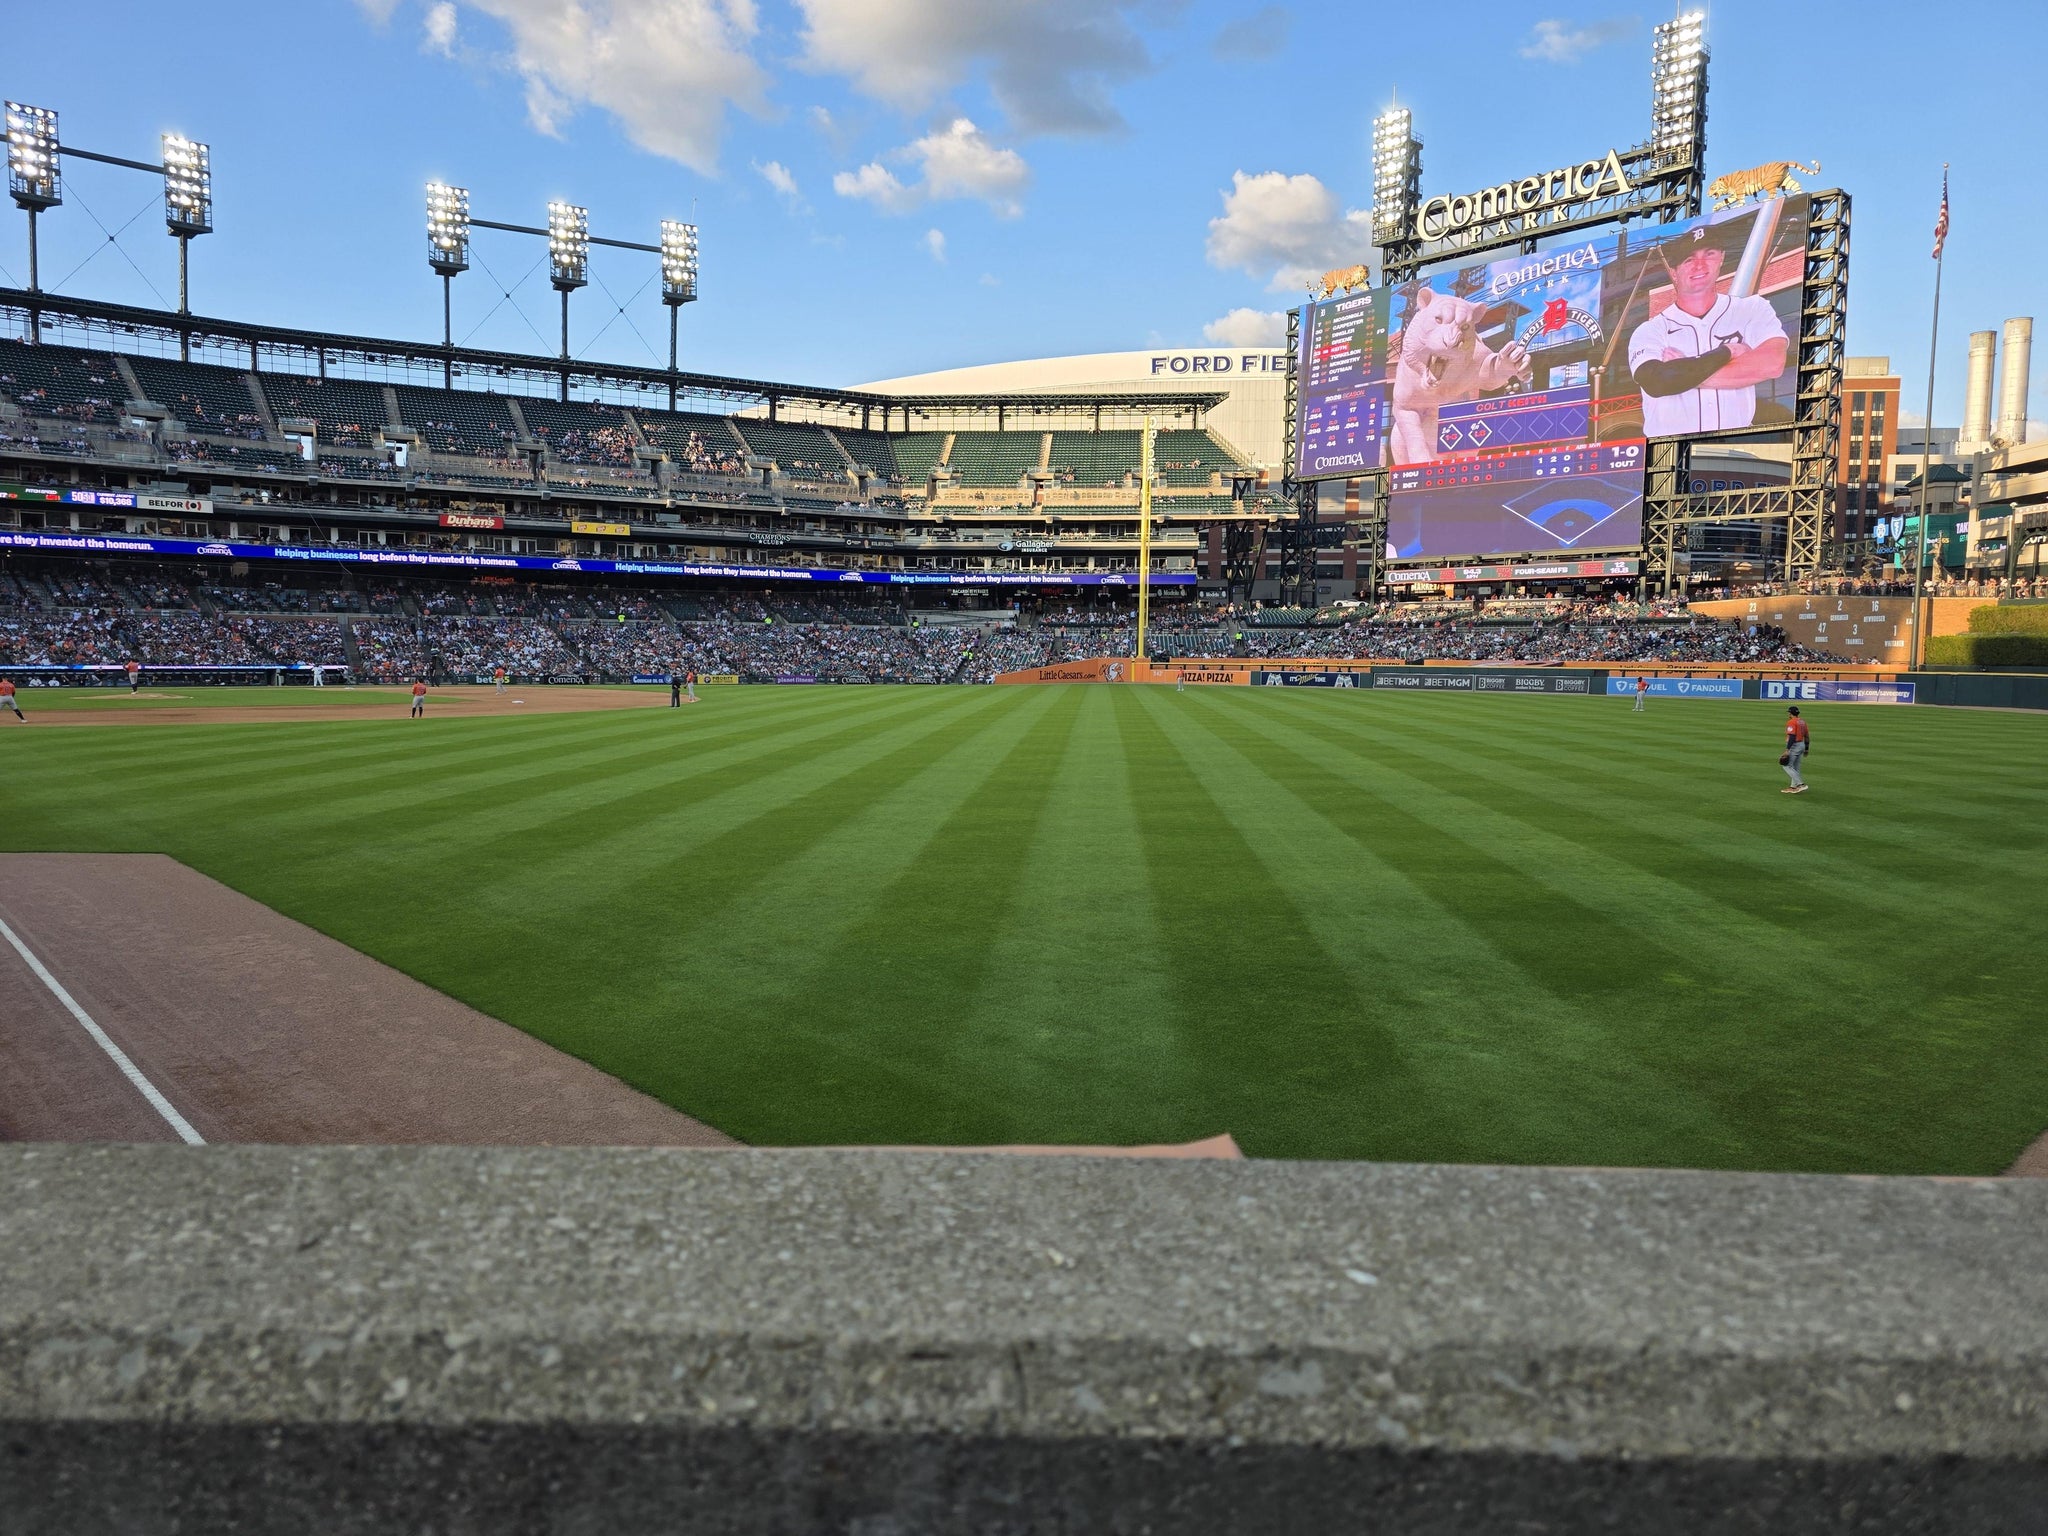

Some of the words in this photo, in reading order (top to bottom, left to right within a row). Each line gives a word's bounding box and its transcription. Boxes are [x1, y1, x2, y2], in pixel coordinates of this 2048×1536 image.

[1470, 204, 1569, 243] PARK
[1521, 275, 1569, 297] PARK
[1335, 296, 1372, 312] TIGERS
[1571, 311, 1601, 340] TIGERS
[1151, 355, 1233, 375] FORD
[1476, 401, 1505, 412] COLT
[1507, 395, 1548, 408] KEITH
[1611, 445, 1640, 459] 1-0
[1402, 470, 1419, 478] HOU
[1550, 455, 1558, 463] 2
[1563, 454, 1571, 462] 0
[1549, 467, 1557, 475] 2
[149, 500, 183, 508] BELFOR
[447, 515, 495, 527] Dunham's
[13, 535, 38, 547] they
[40, 537, 86, 546] invented
[87, 539, 105, 548] the
[106, 540, 154, 550] homerun.
[750, 533, 791, 542] CHAMPIONS
[1016, 541, 1054, 549] Gallagher
[275, 548, 309, 559] Helping
[310, 550, 358, 560] businesses
[359, 551, 379, 562] long
[379, 552, 407, 562] before
[408, 554, 428, 564] they
[429, 555, 464, 564] invented
[465, 556, 480, 565] the
[480, 557, 519, 567] homerun.
[615, 563, 644, 573] Helping
[644, 564, 683, 573] businesses
[684, 565, 699, 575] long
[700, 567, 723, 575] before
[723, 568, 739, 577] they
[739, 568, 769, 577] invented
[781, 570, 812, 579] homerun.
[890, 574, 915, 584] Helping
[915, 575, 950, 583] businesses
[950, 574, 965, 584] long
[965, 575, 987, 583] before
[986, 575, 1001, 584] they
[1002, 575, 1029, 583] invented
[1030, 575, 1042, 583] the
[1042, 575, 1073, 583] homerun.
[1749, 602, 1757, 612] 23
[1805, 600, 1811, 610] 5
[1837, 600, 1843, 611] 2
[1871, 601, 1879, 612] 16
[1818, 623, 1827, 633] 47
[1852, 624, 1858, 635] 3
[1893, 625, 1897, 637] 1
[1040, 671, 1057, 680] Little
[1180, 673, 1205, 682] IZZA!
[1207, 673, 1234, 683] PIZZA!
[1383, 678, 1420, 686] BETMGM
[1431, 678, 1470, 687] BETMGM
[1691, 685, 1732, 693] FANDUEL
[1767, 682, 1816, 698] DTE
